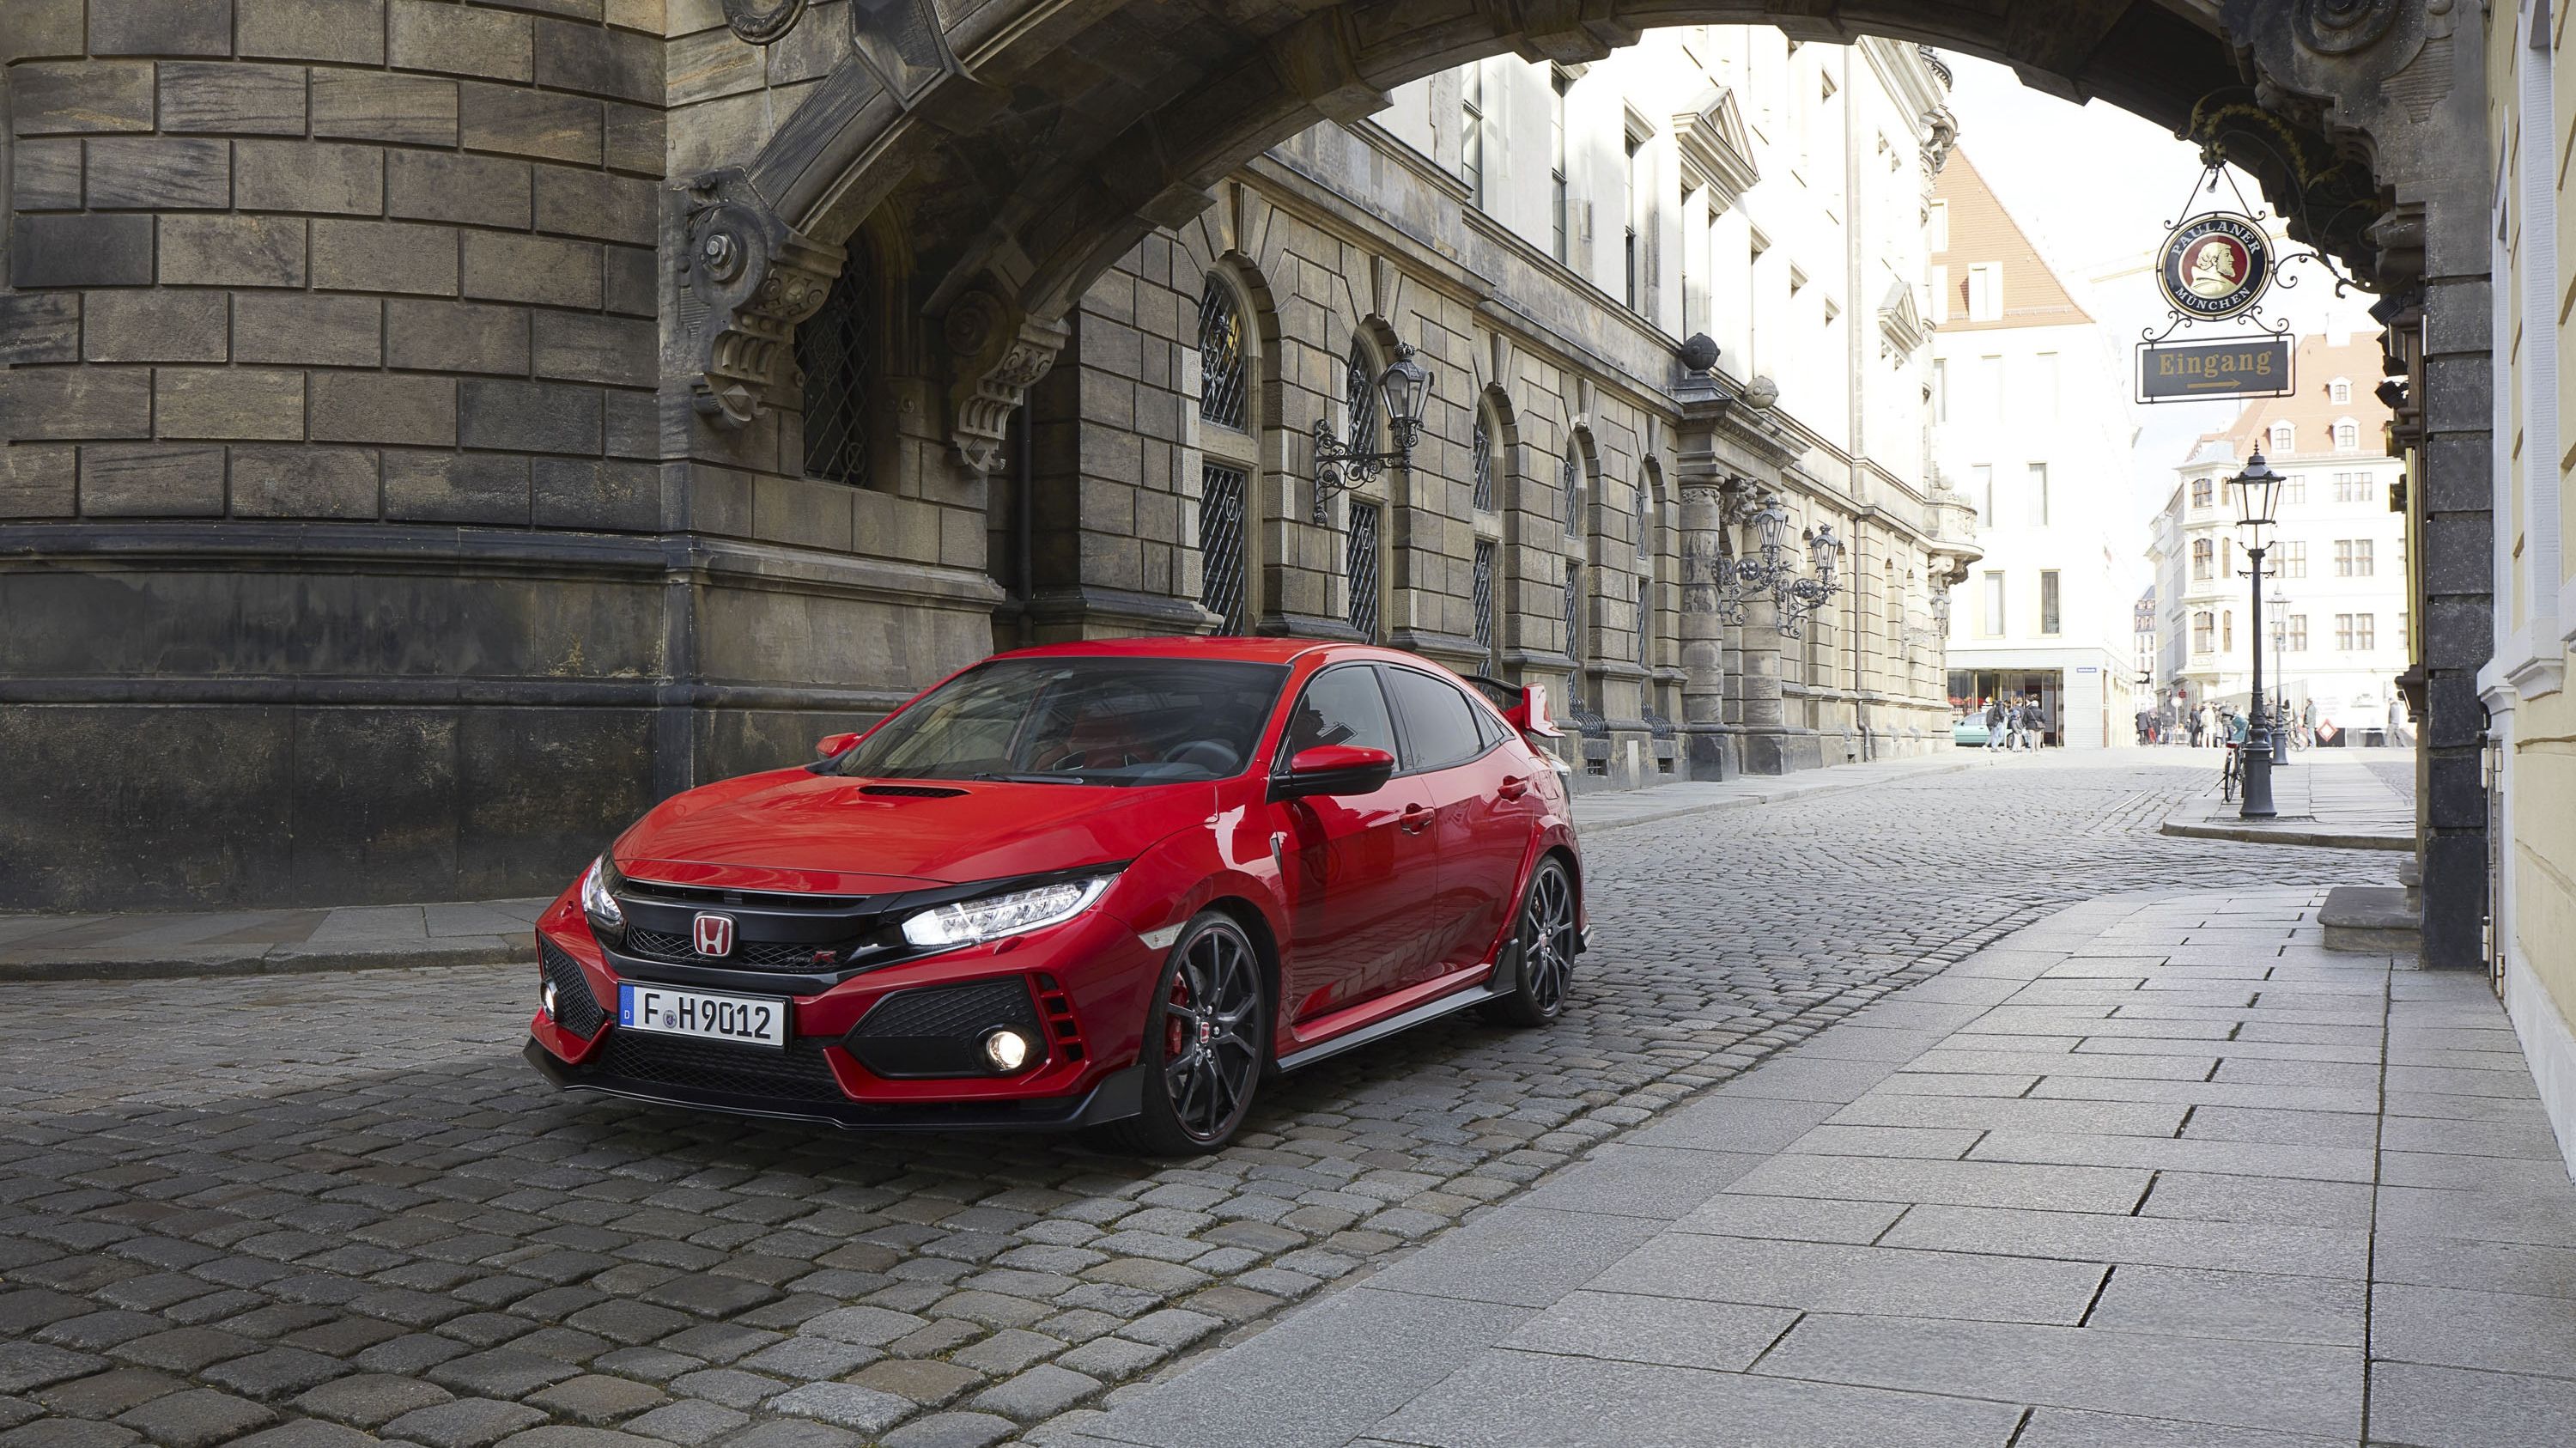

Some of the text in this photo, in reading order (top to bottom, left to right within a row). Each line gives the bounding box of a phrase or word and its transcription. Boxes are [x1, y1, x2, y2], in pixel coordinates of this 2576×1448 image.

[2172, 222, 2261, 255] PAULANER
[2175, 286, 2251, 310] MÜNCHEN
[2159, 350, 2272, 378] Eingang
[624, 1010, 630, 1019] D
[644, 993, 660, 1025] F
